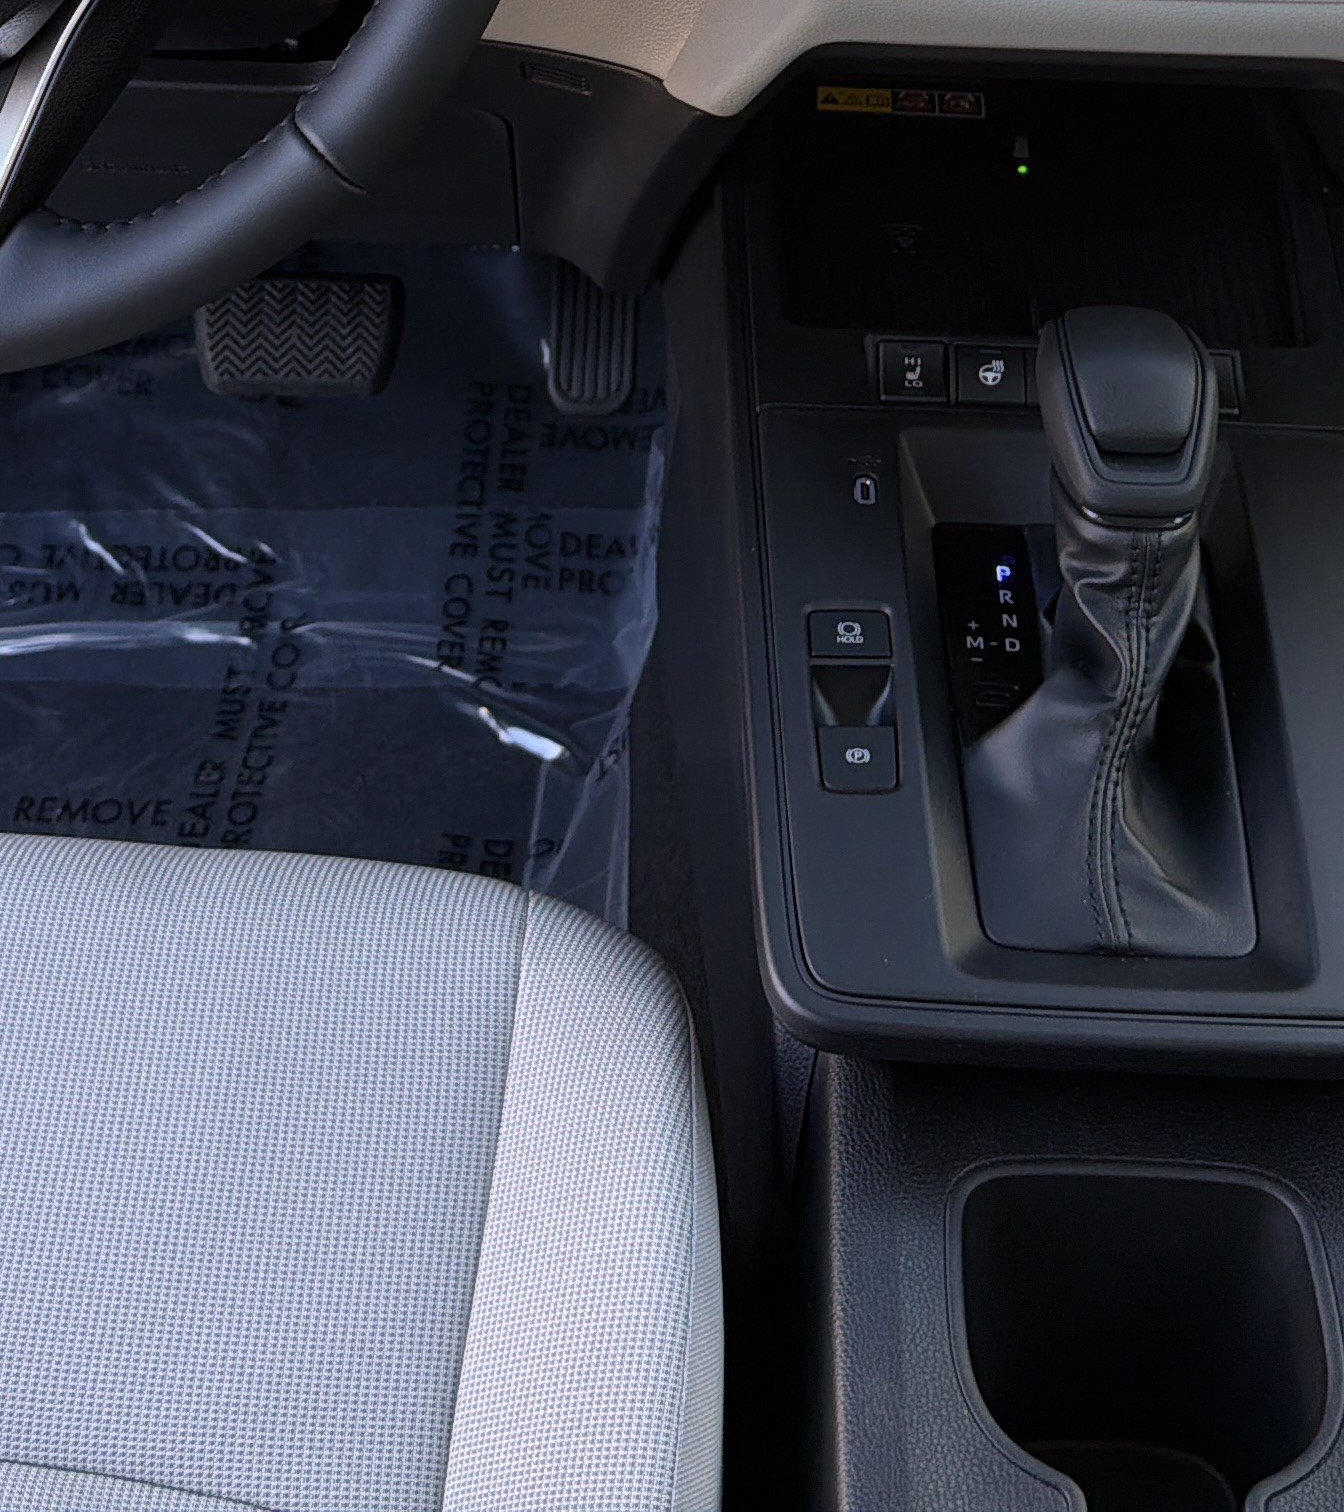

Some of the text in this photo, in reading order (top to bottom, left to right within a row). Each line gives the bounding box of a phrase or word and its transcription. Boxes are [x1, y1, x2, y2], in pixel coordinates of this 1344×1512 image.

[996, 565, 1011, 582] P
[1000, 590, 1014, 605] R
[1002, 614, 1018, 628] N
[837, 636, 864, 644] HOLD
[966, 636, 984, 649] M
[1005, 637, 1020, 652] D
[13, 795, 175, 829] REMOVE
